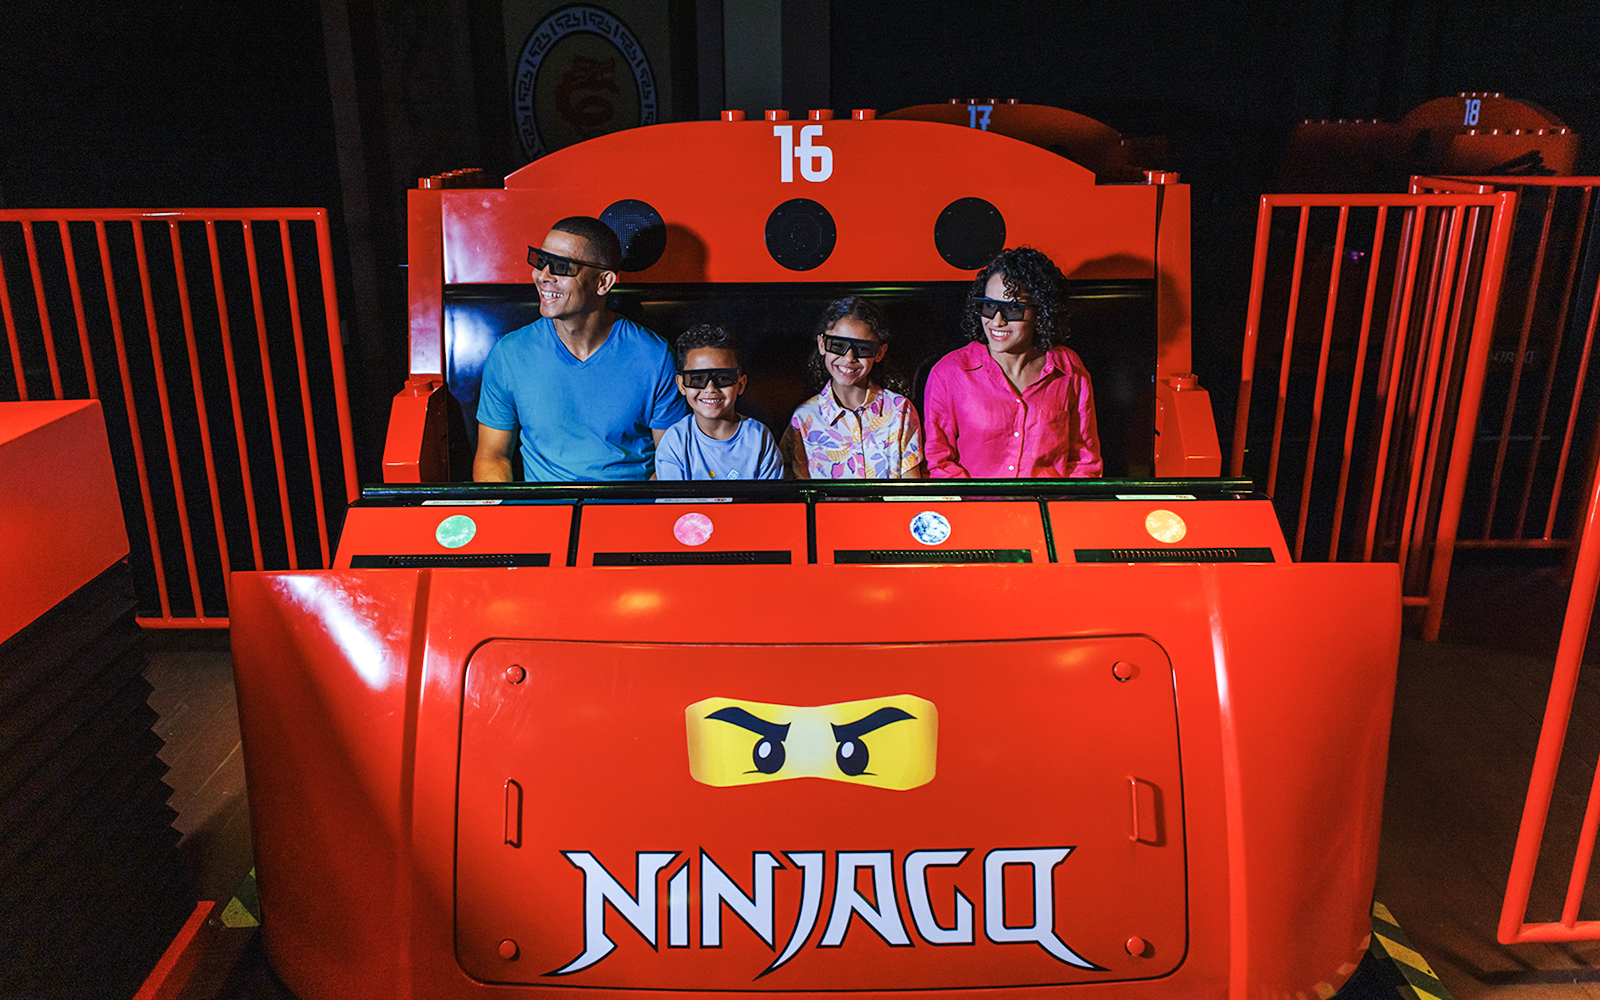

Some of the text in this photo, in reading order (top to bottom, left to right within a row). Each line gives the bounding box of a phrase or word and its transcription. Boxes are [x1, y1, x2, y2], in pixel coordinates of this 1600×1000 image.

[967, 105, 993, 131] 17
[1464, 99, 1481, 126] 18
[773, 124, 834, 183] 16
[540, 846, 1111, 981] NINJAGO
